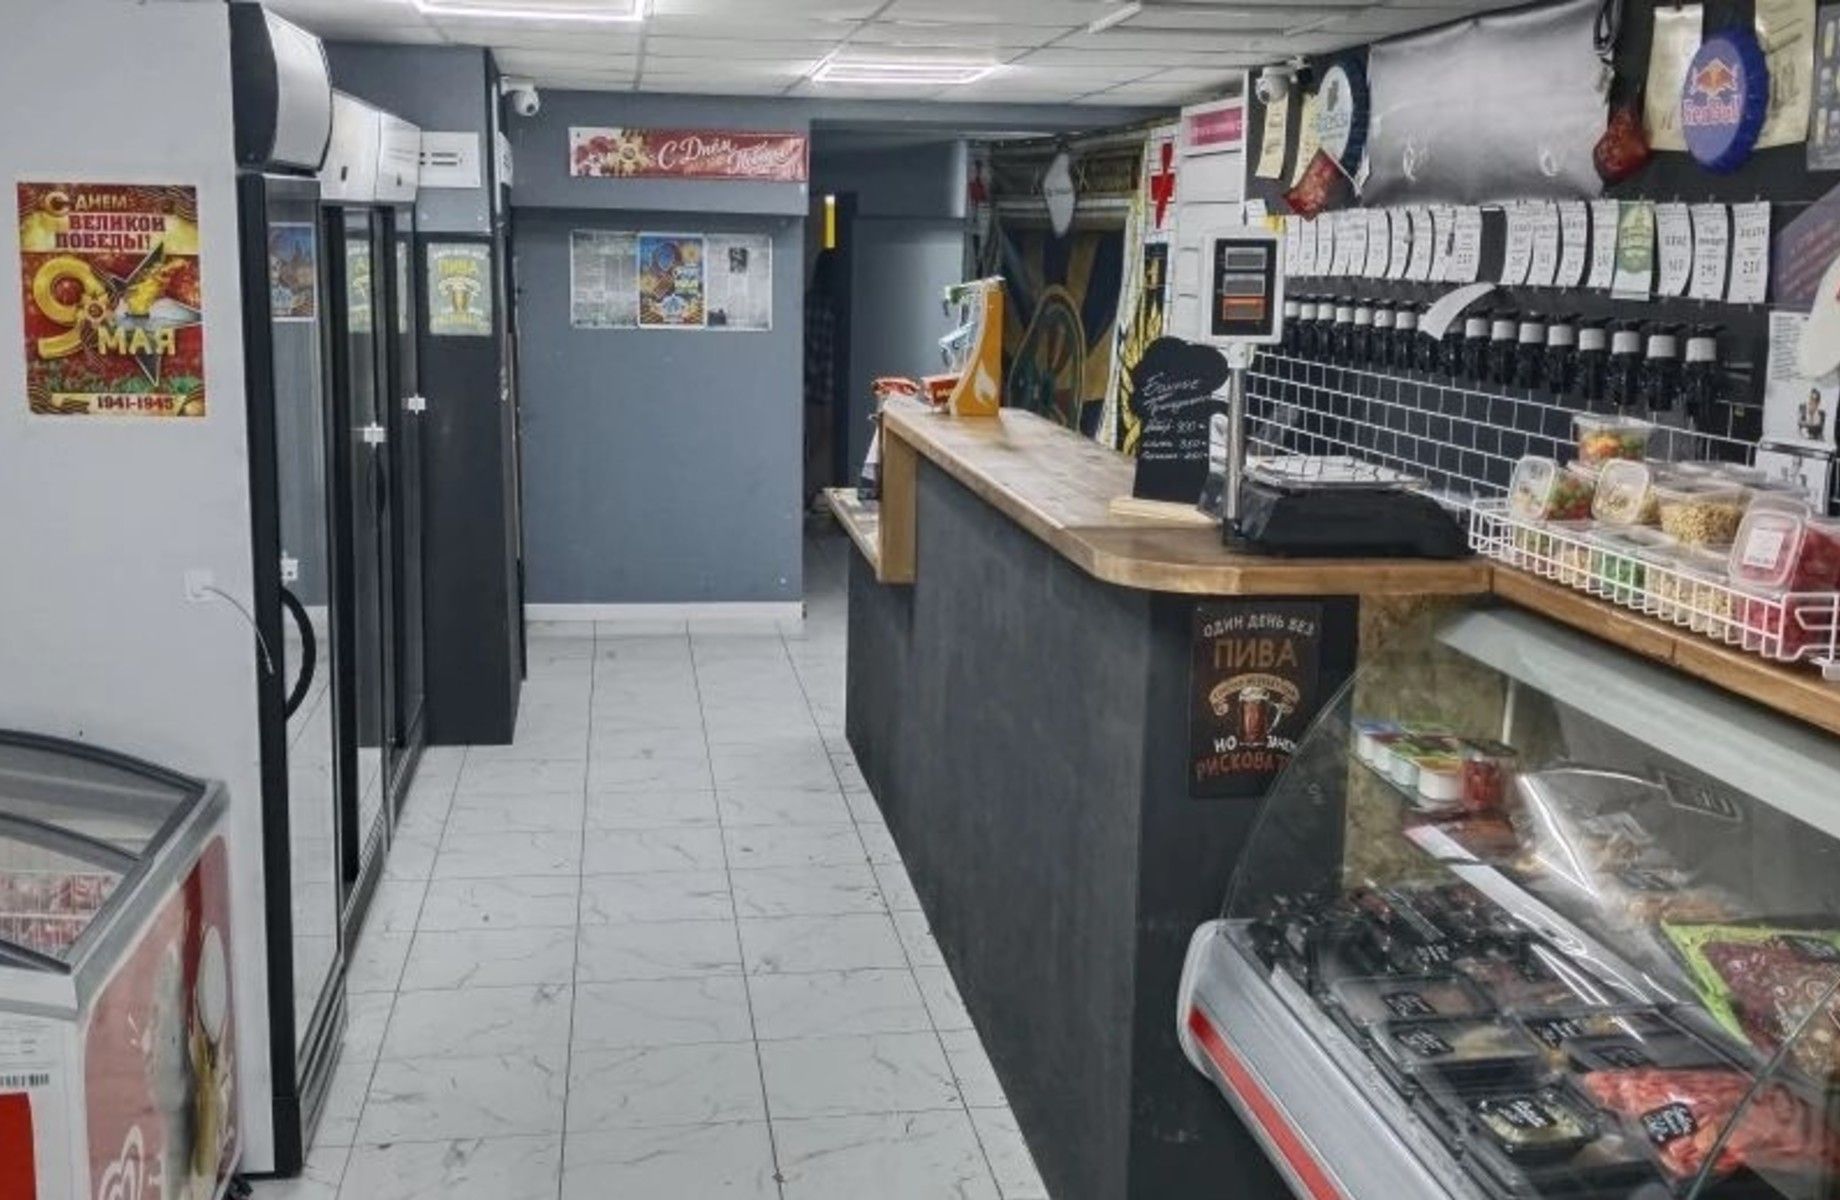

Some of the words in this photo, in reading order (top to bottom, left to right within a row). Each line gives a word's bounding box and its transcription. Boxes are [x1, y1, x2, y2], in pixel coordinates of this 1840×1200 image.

[45, 191, 70, 217] С
[98, 325, 176, 355] МАЯ
[97, 395, 174, 410] 1941-1945
[1203, 616, 1243, 637] ОДИН
[1247, 613, 1284, 630] ДЕНЬ
[1287, 619, 1315, 637] БЕЗ
[1213, 638, 1299, 668] ПИВА
[1213, 735, 1238, 753] НО
[1196, 752, 1294, 783] РИСКОВАТ
